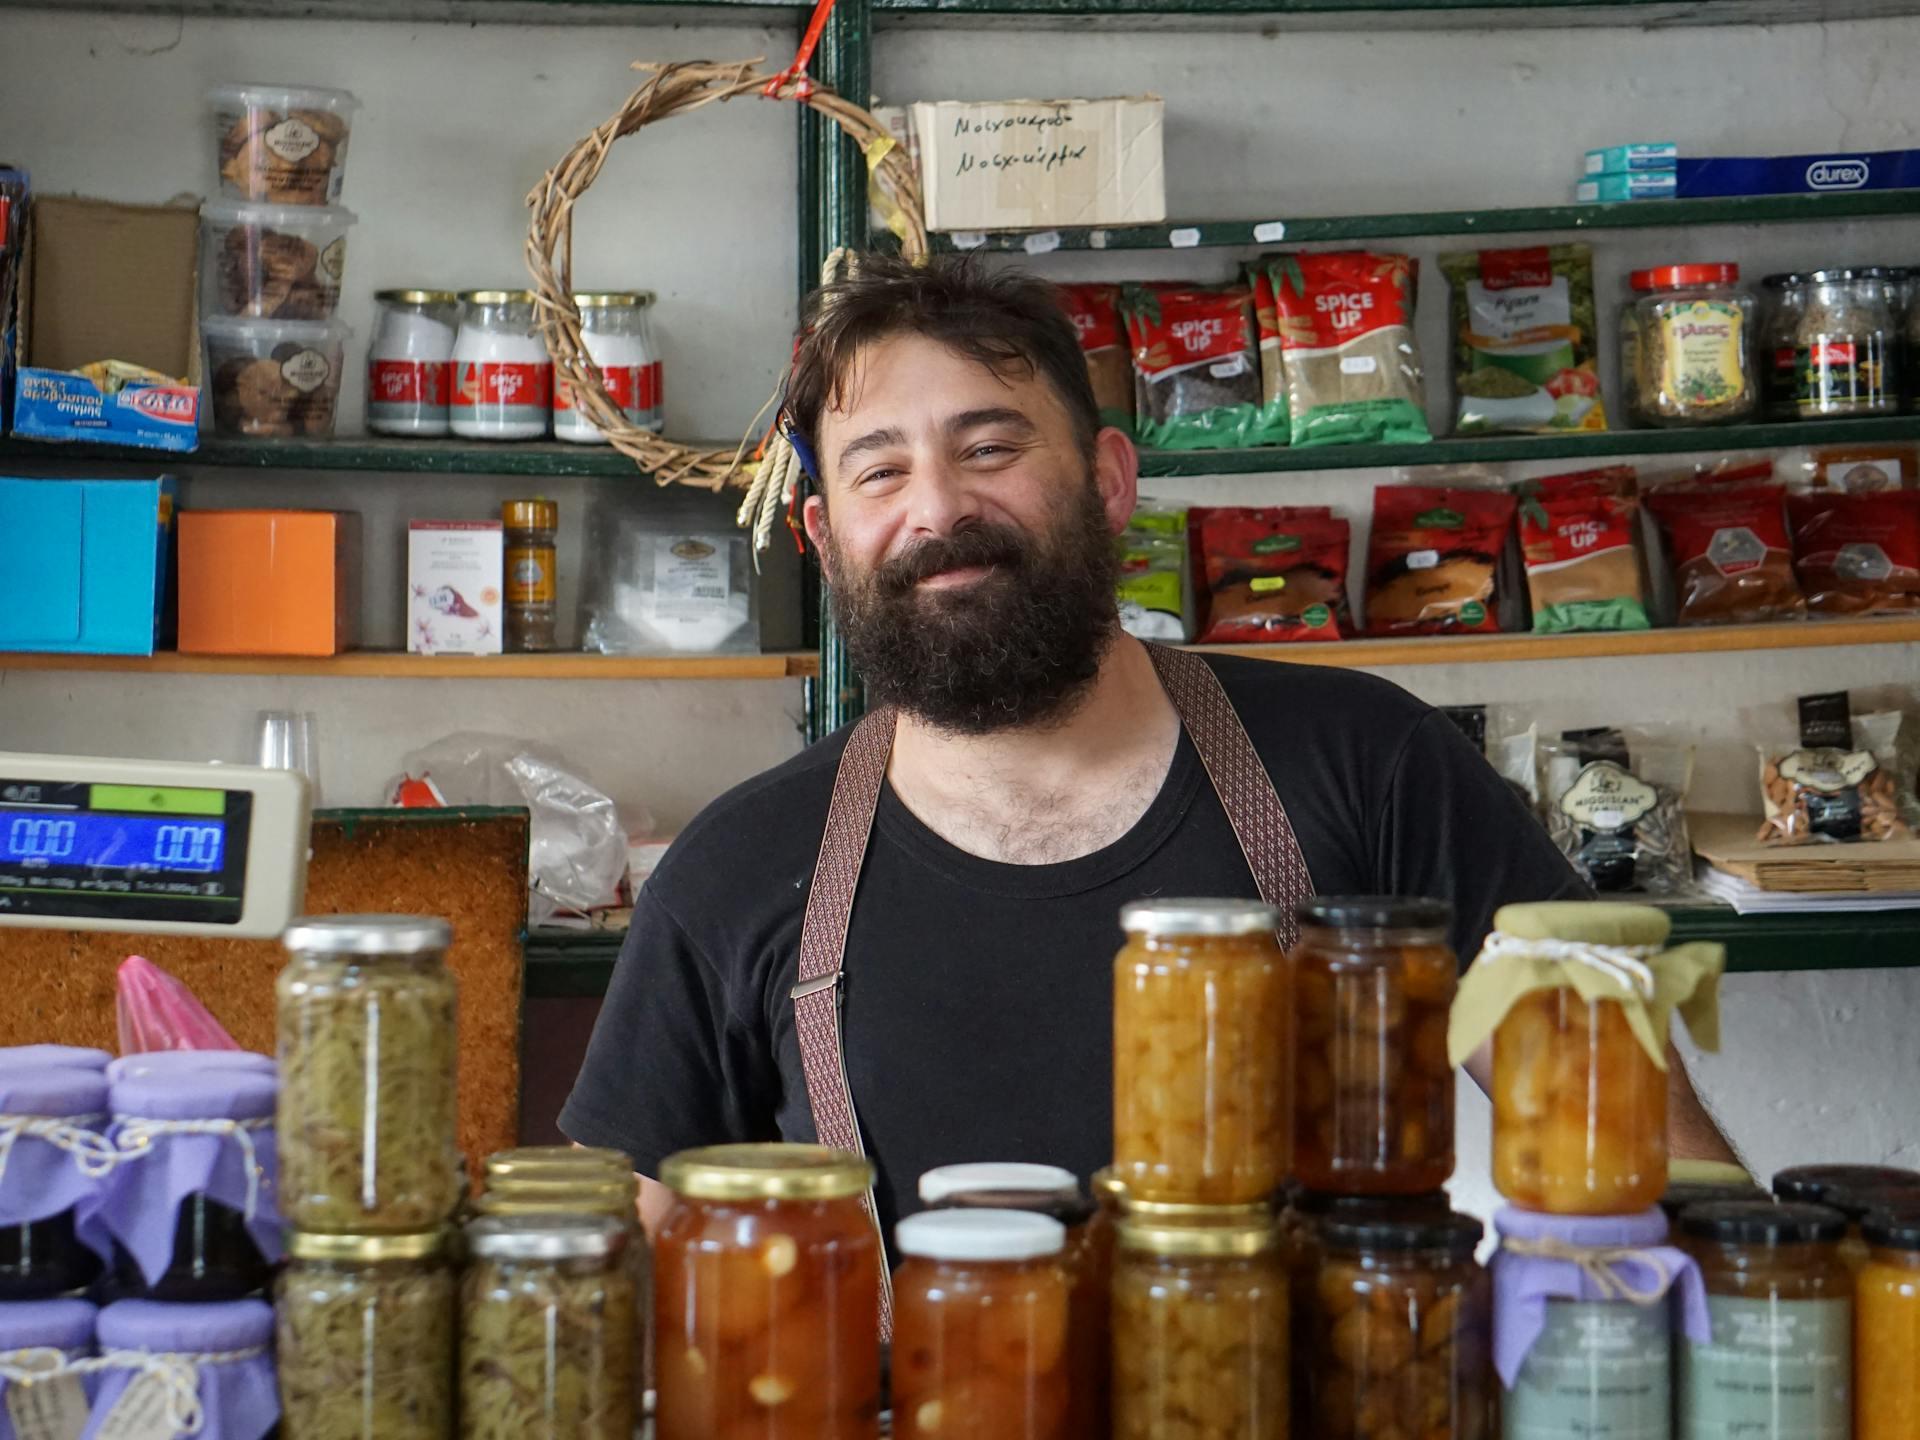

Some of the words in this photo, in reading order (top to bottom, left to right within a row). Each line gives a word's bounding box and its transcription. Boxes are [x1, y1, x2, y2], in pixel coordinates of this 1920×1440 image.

[1812, 165, 1864, 184] durex
[1315, 292, 1374, 312] SPICE
[1171, 318, 1223, 338] SPICE
[1331, 310, 1362, 329] UP
[1184, 335, 1212, 352] UP
[381, 372, 411, 386] SPICE
[489, 374, 524, 388] SPICE
[386, 384, 403, 396] UP
[498, 385, 516, 398] UP
[1557, 520, 1608, 537] SPICE
[1570, 534, 1598, 548] UP
